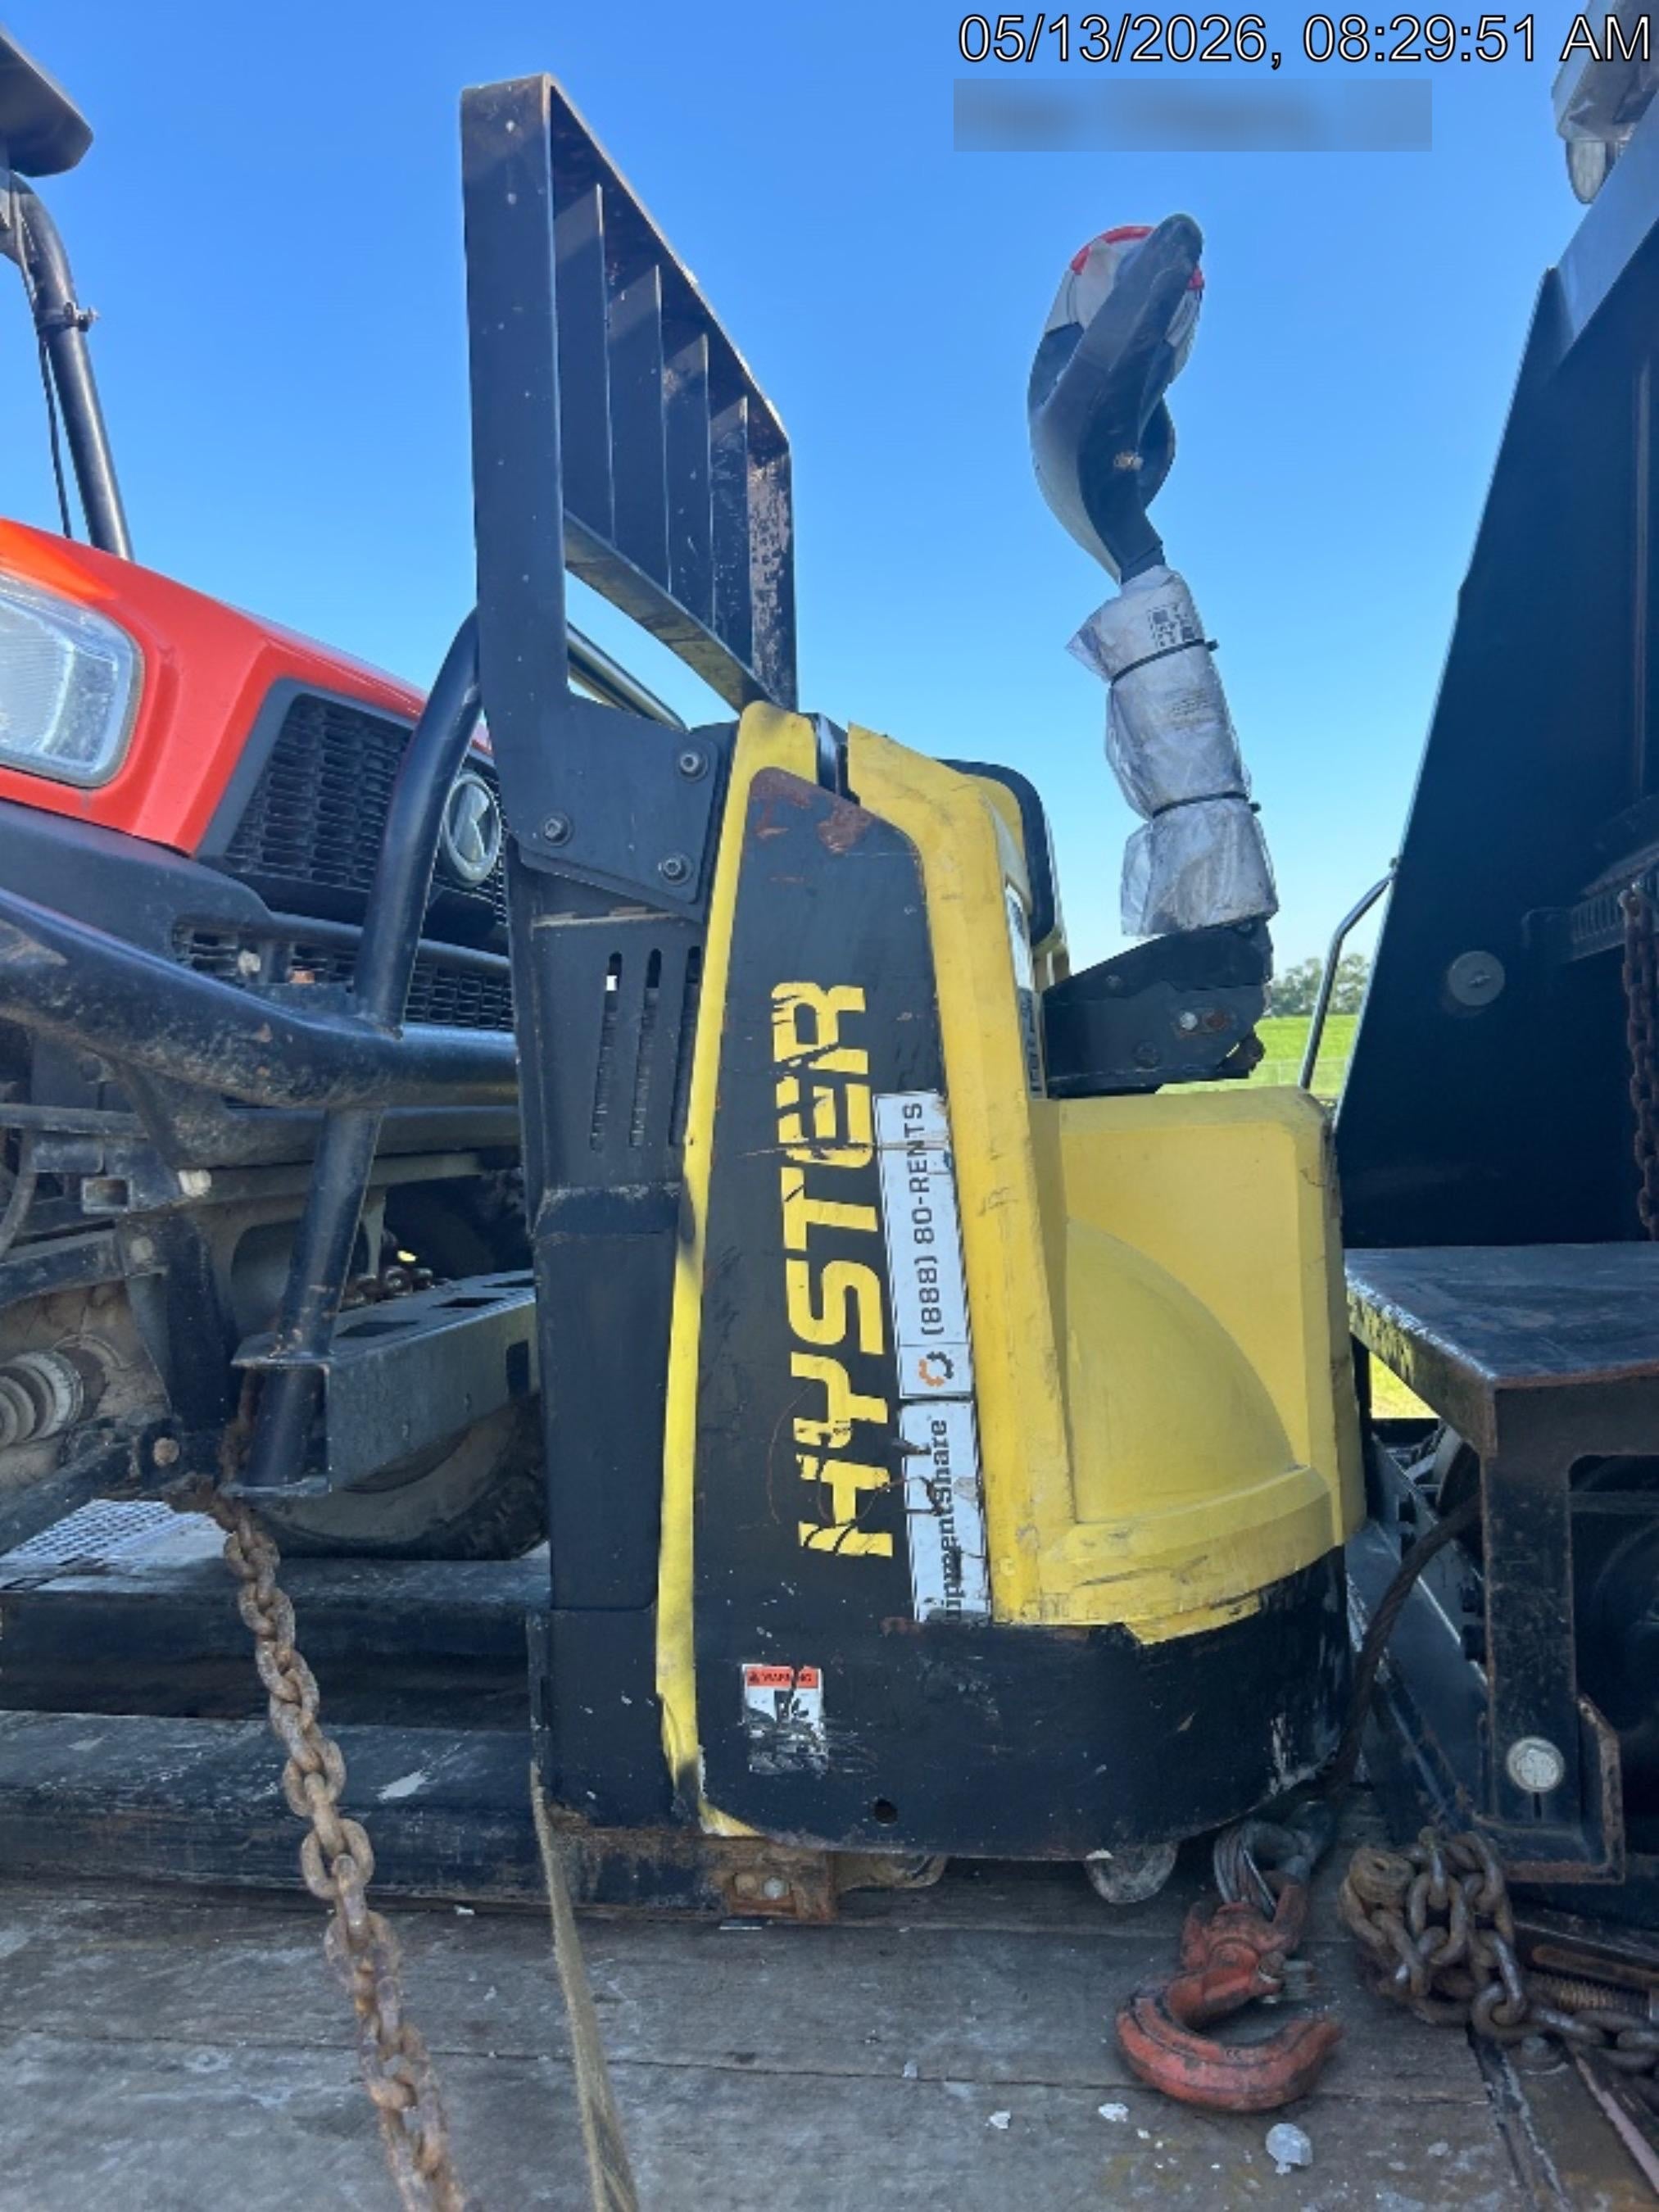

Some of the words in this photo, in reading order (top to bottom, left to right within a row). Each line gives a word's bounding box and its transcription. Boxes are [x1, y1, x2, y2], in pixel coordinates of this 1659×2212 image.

[902, 1102, 936, 1245] 80-RENTS
[771, 981, 894, 1558] HYSTER
[913, 1255, 945, 1335] (888)
